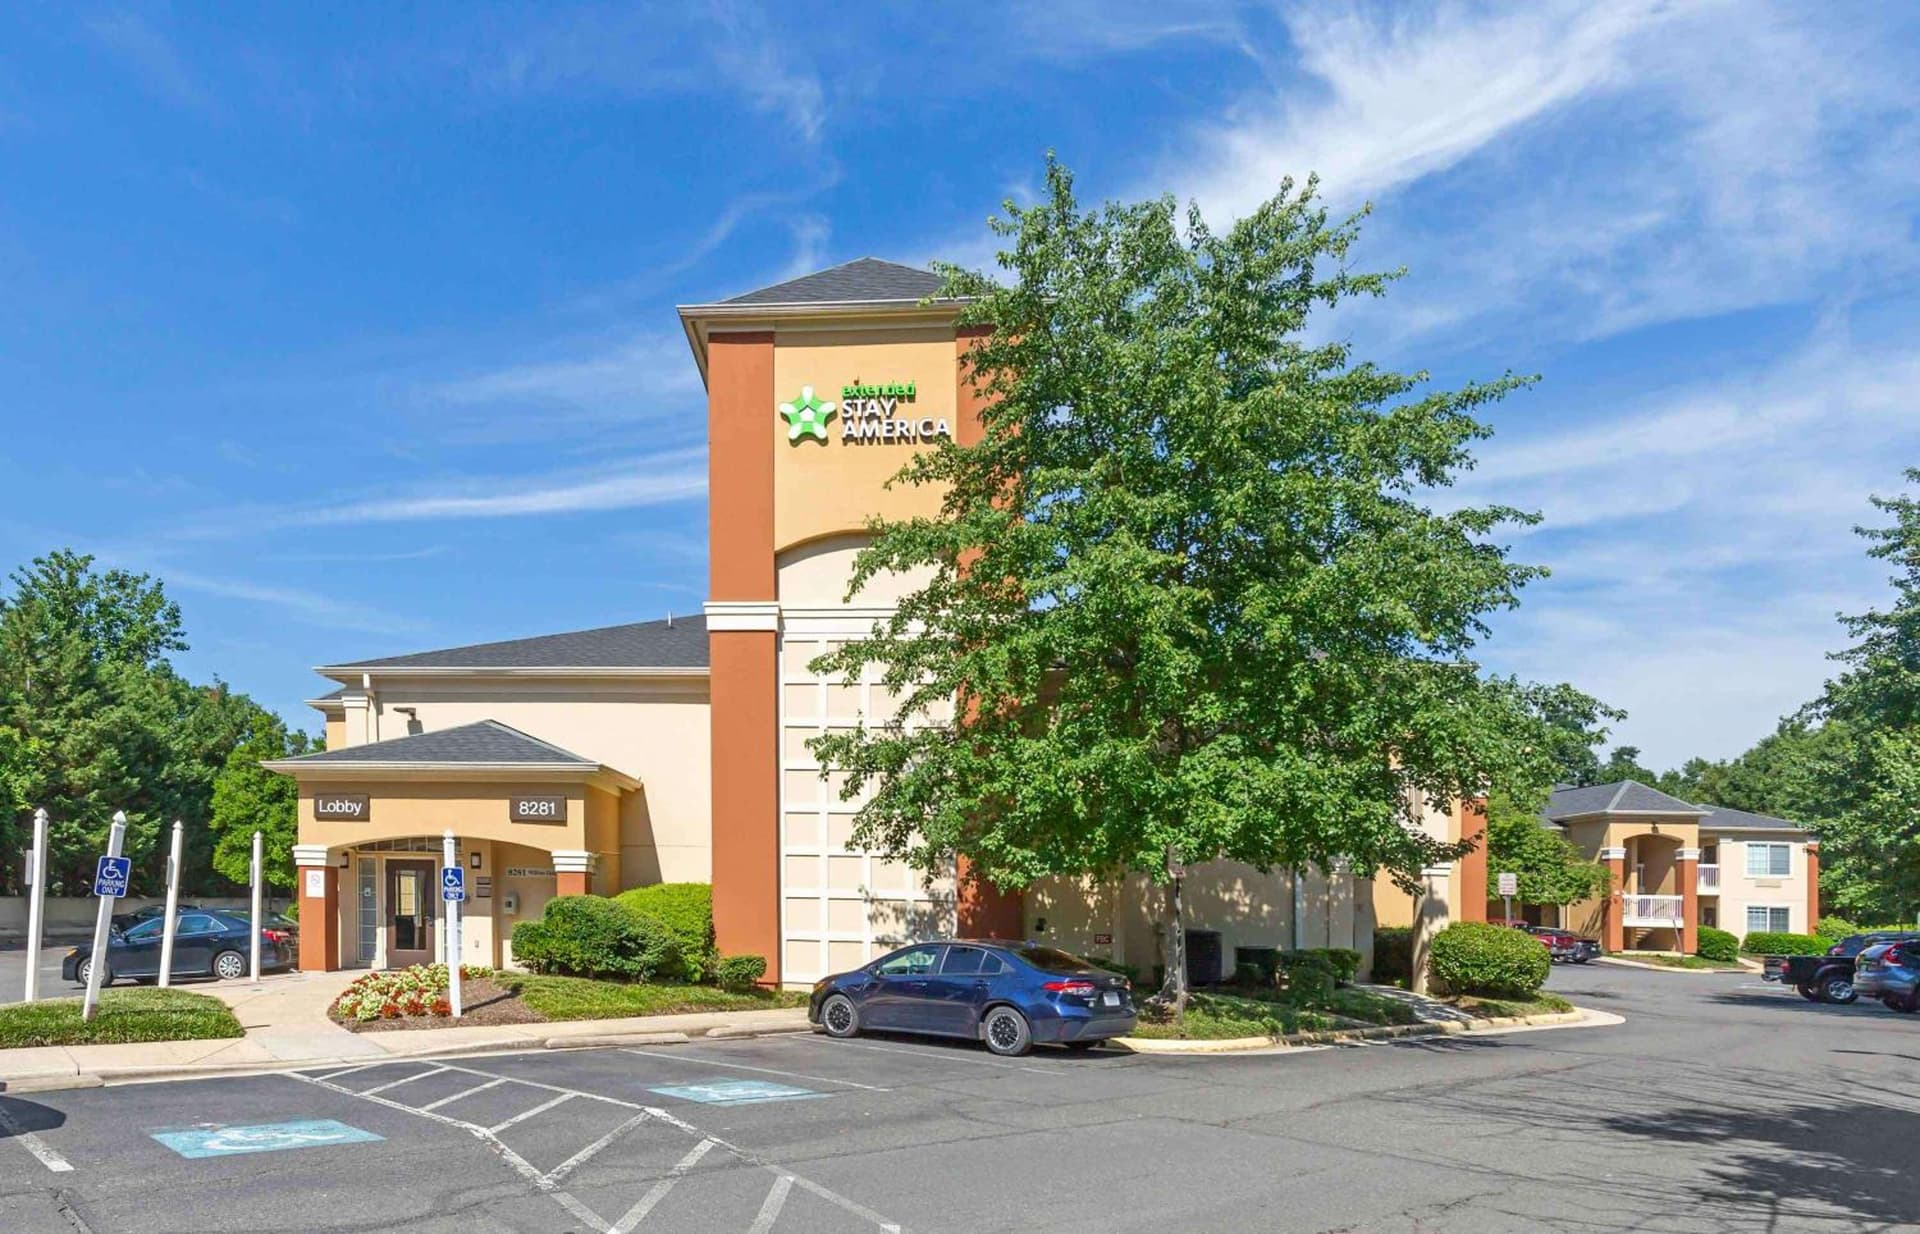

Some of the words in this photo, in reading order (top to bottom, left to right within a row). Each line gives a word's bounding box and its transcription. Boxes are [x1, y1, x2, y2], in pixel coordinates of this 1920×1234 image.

[842, 381, 915, 396] extended
[842, 398, 896, 417] STAY
[842, 418, 951, 438] AMERICA
[319, 799, 362, 816] Lobby
[519, 801, 555, 816] 8281
[98, 878, 125, 888] PARKING
[101, 886, 119, 895] ONLY
